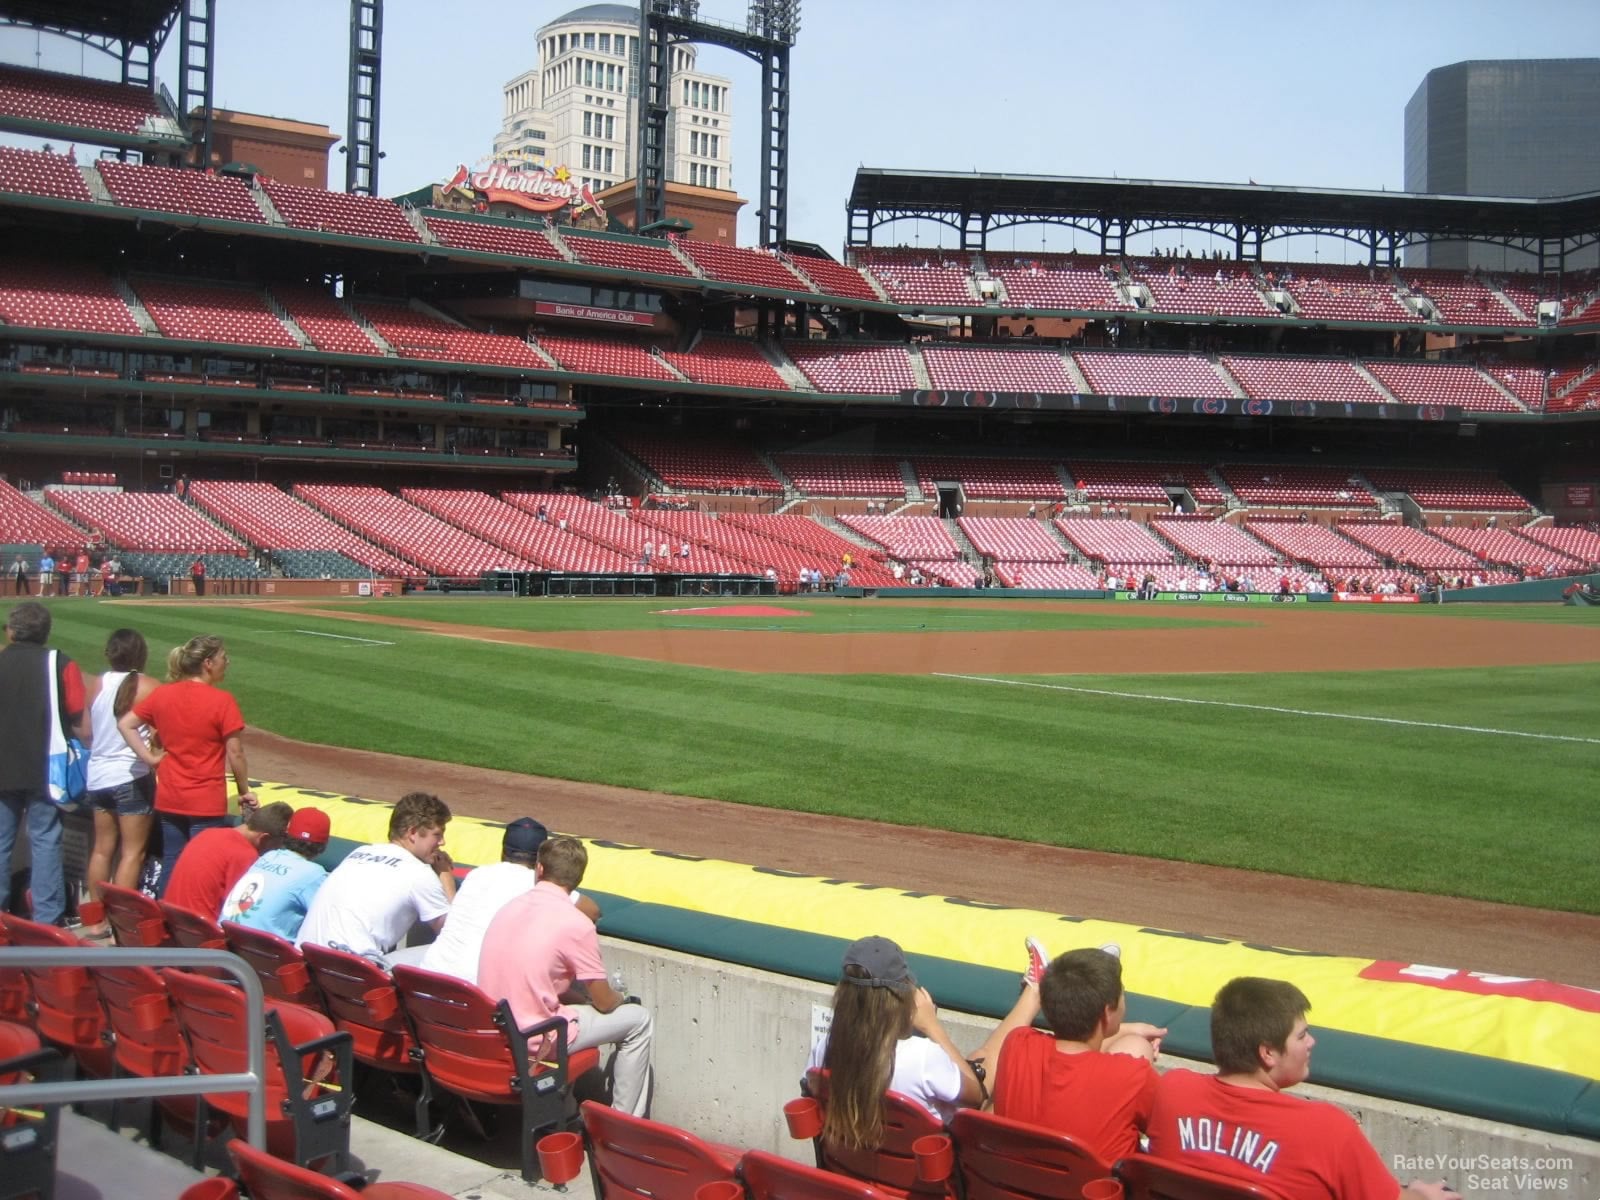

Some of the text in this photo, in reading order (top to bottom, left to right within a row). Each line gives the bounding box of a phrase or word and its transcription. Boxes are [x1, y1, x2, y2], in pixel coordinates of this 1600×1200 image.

[555, 305, 574, 314] Bank
[586, 309, 616, 320] America
[618, 313, 634, 321] Club
[1178, 1117, 1279, 1174] MOLINA
